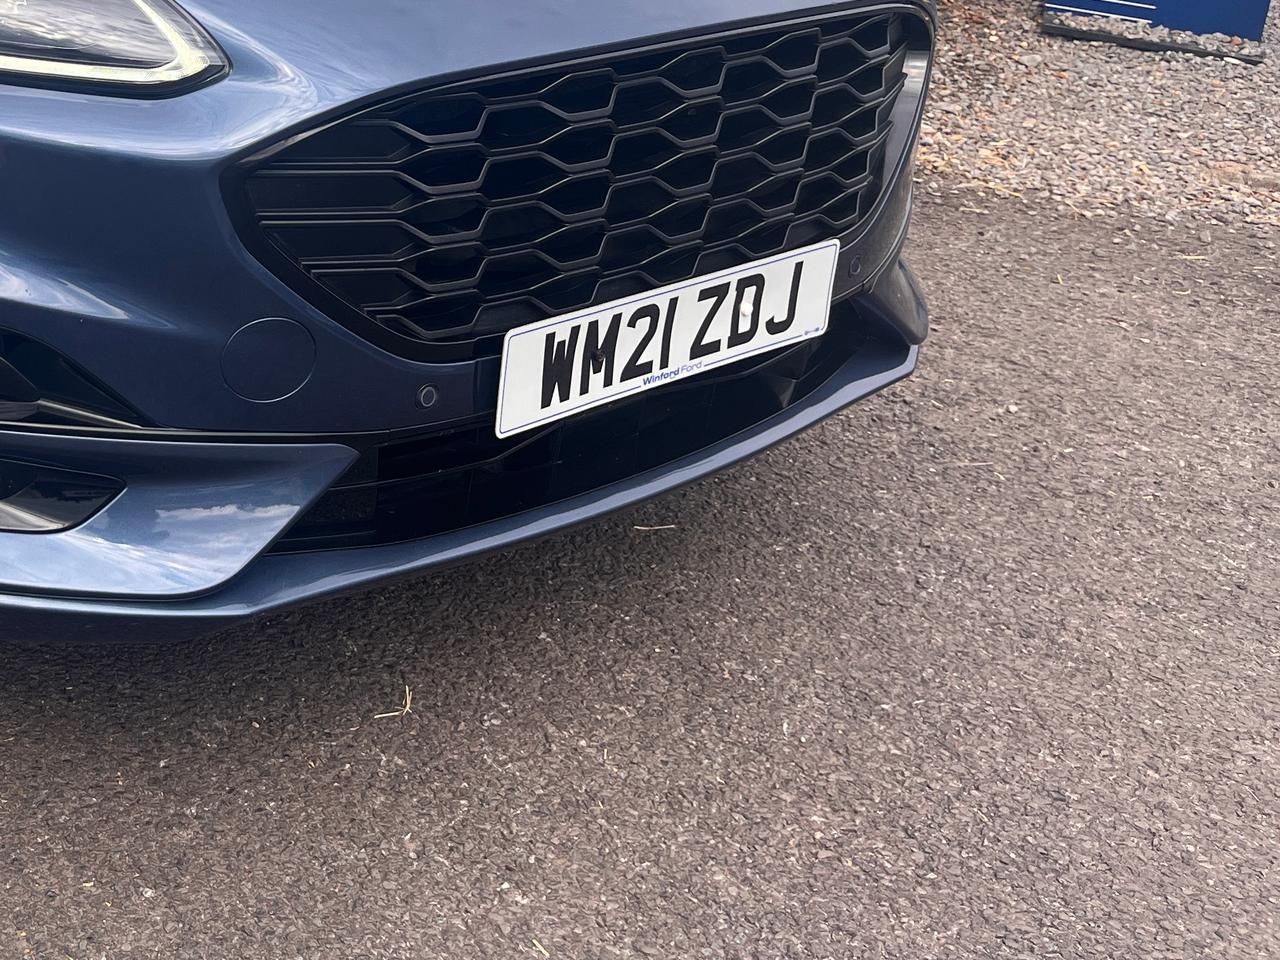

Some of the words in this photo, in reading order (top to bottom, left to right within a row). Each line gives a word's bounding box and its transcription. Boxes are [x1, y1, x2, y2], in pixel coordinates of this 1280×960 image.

[540, 295, 680, 410] WM21
[689, 260, 804, 361] ZDJ
[642, 367, 680, 386] Winford
[680, 360, 703, 375] Ford
